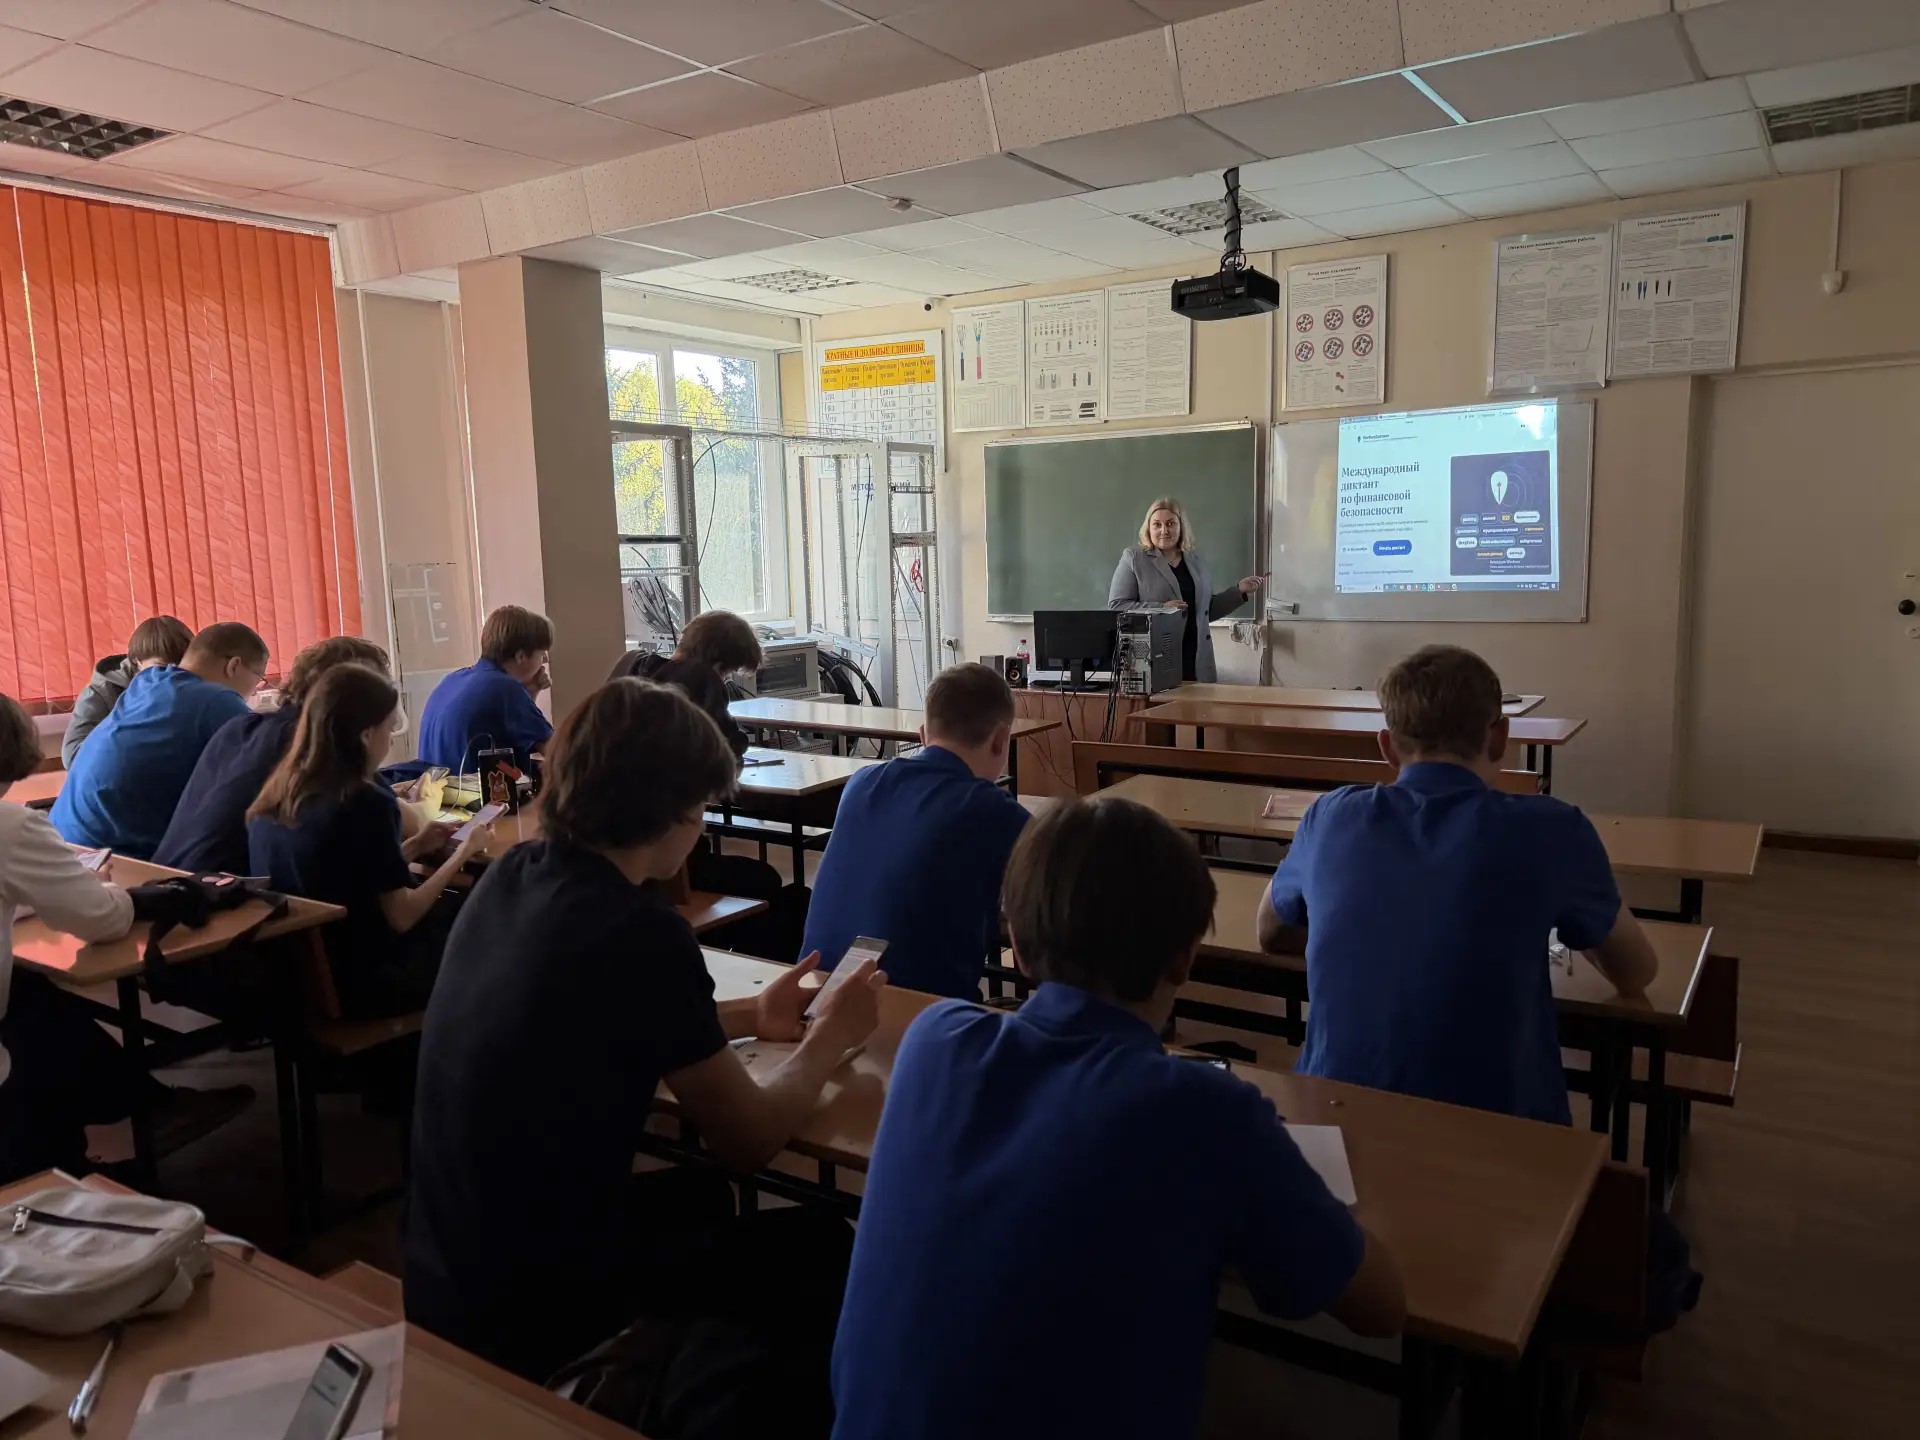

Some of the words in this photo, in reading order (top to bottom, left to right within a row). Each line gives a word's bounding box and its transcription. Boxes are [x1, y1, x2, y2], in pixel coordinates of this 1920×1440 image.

[826, 351, 854, 361] КРАТНЫЕ
[892, 343, 924, 354] ЕДИНИЦЫ
[1341, 462, 1420, 478] Международный
[1340, 480, 1380, 492] диктант
[1340, 494, 1352, 504] по
[1353, 489, 1411, 506] финансовой
[1340, 506, 1404, 518] безопасности
